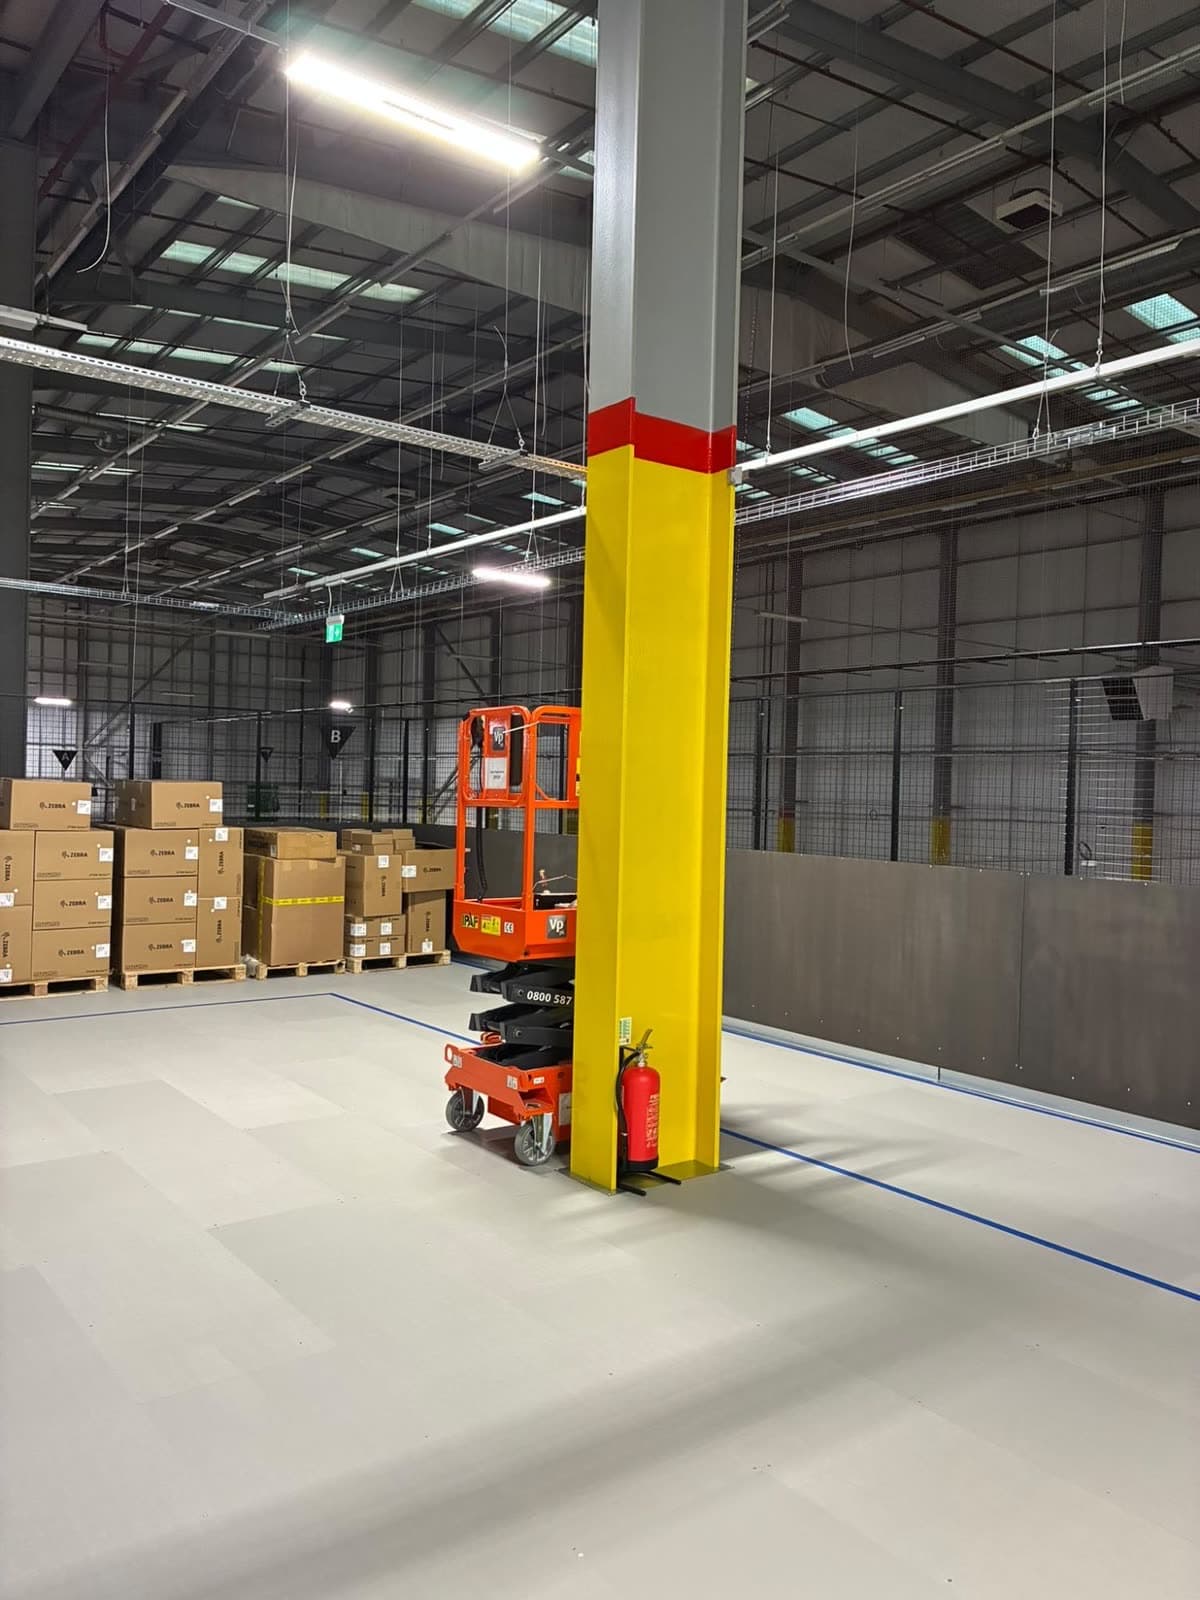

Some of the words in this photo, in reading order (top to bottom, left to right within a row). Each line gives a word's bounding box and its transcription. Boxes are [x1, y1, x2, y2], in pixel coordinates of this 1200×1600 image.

[330, 729, 341, 743] B
[61, 752, 70, 761] A
[549, 918, 564, 933] Vp
[526, 990, 552, 1003] 0800
[553, 994, 573, 1006] 587
